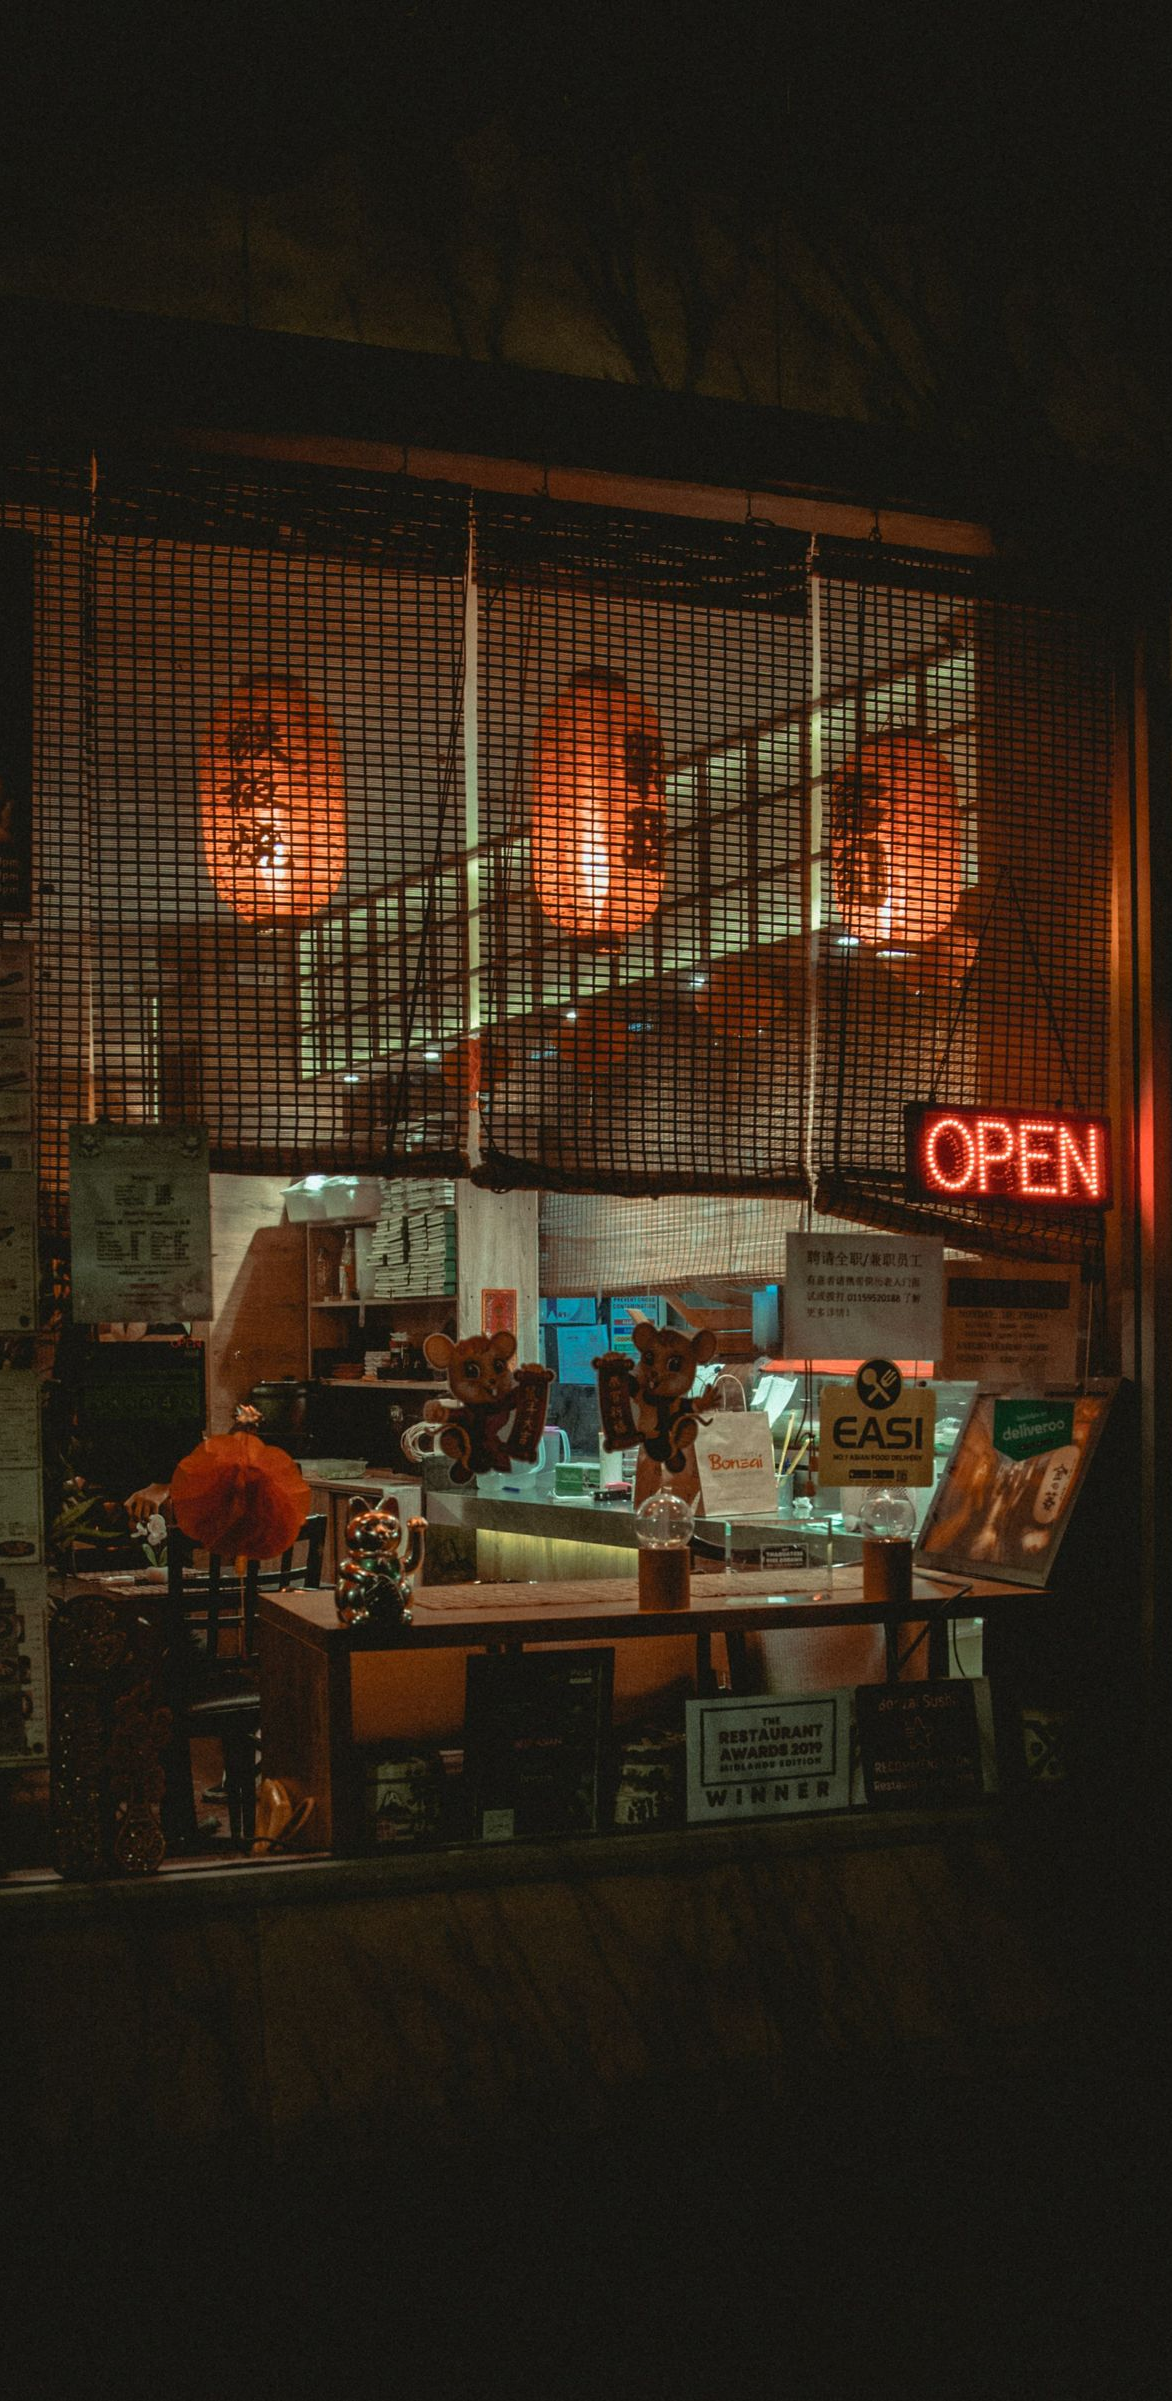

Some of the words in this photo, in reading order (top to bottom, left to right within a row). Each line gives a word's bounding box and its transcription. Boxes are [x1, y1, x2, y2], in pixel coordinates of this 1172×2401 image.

[925, 1118, 1100, 1197] OPEN
[833, 1416, 923, 1449] EASI
[1002, 1419, 1066, 1442] deliveroo
[708, 1453, 763, 1471] Bonzai
[762, 1716, 781, 1727] THE
[719, 1723, 823, 1745] RESTAURANT
[719, 1744, 788, 1762] AWARDS
[790, 1741, 823, 1756] 2019
[720, 1761, 775, 1773] MIDLANDS
[779, 1757, 822, 1770] EDITION
[706, 1779, 829, 1808] WINNER
